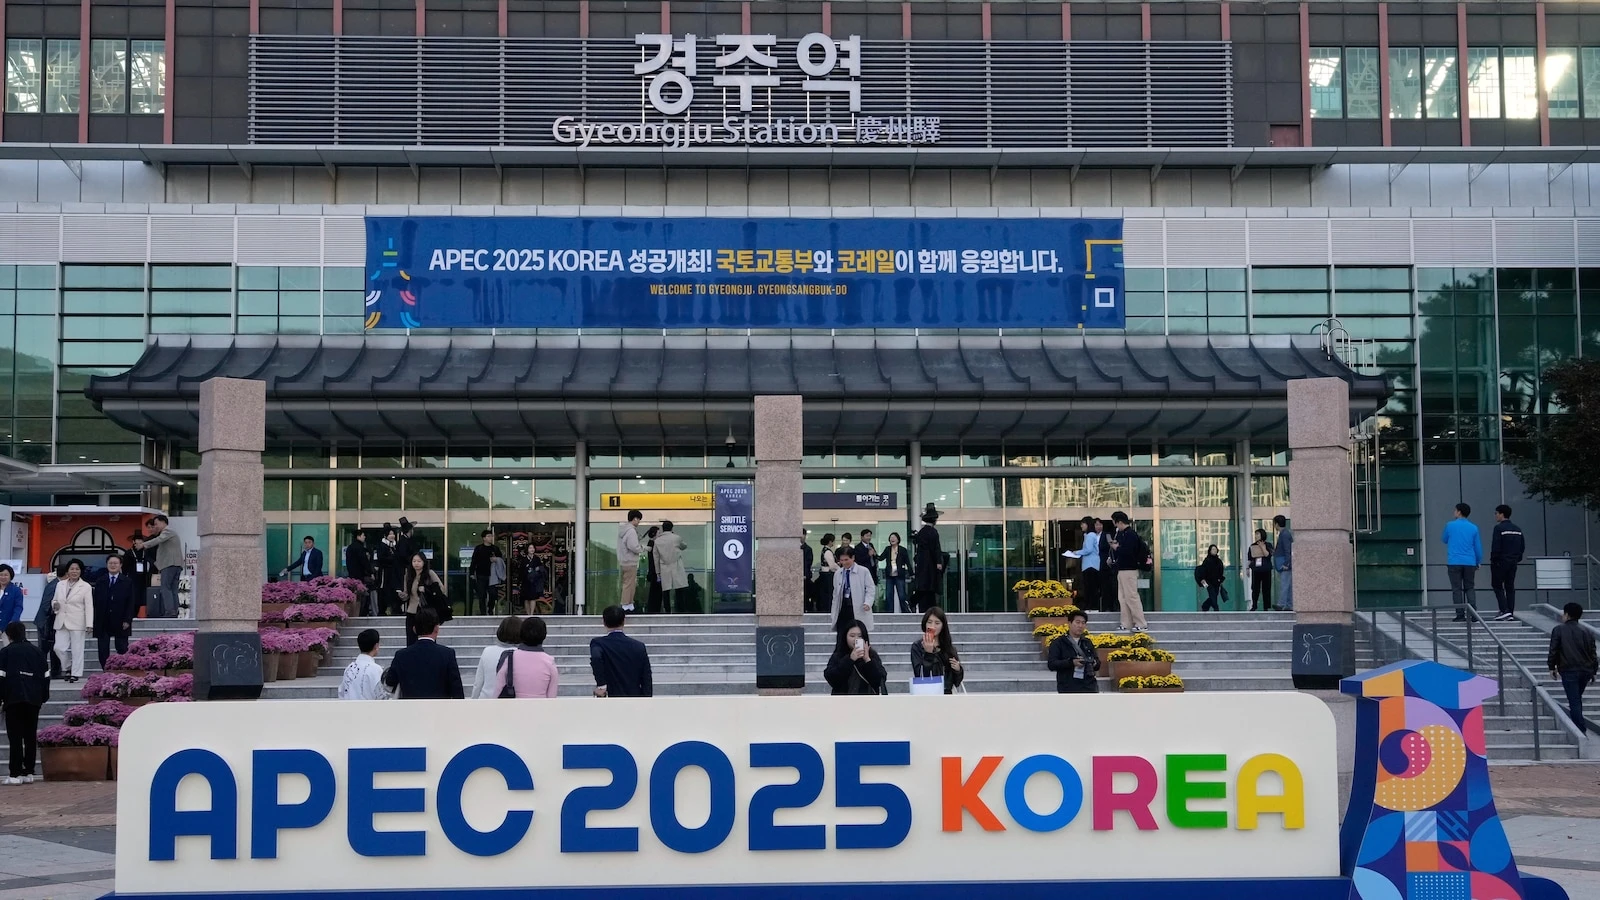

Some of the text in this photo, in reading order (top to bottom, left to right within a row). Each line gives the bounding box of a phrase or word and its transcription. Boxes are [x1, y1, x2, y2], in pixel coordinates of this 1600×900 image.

[634, 33, 863, 114] 경주역
[552, 116, 941, 148] Gyeongju Station 慶州驛
[429, 249, 1064, 274] APEC 2025 KOREA 성공개최! 국토교통부와 코레일이 함께 응원합니다.
[650, 284, 692, 295] WELCOME
[695, 284, 706, 295] TO
[758, 284, 847, 296] GYEONGSANGBUK-DO
[611, 497, 619, 506] 1
[721, 515, 747, 524] SHUTTLE
[719, 525, 748, 533] SERVICES
[149, 740, 1306, 862] APEC 2025 KOREA
